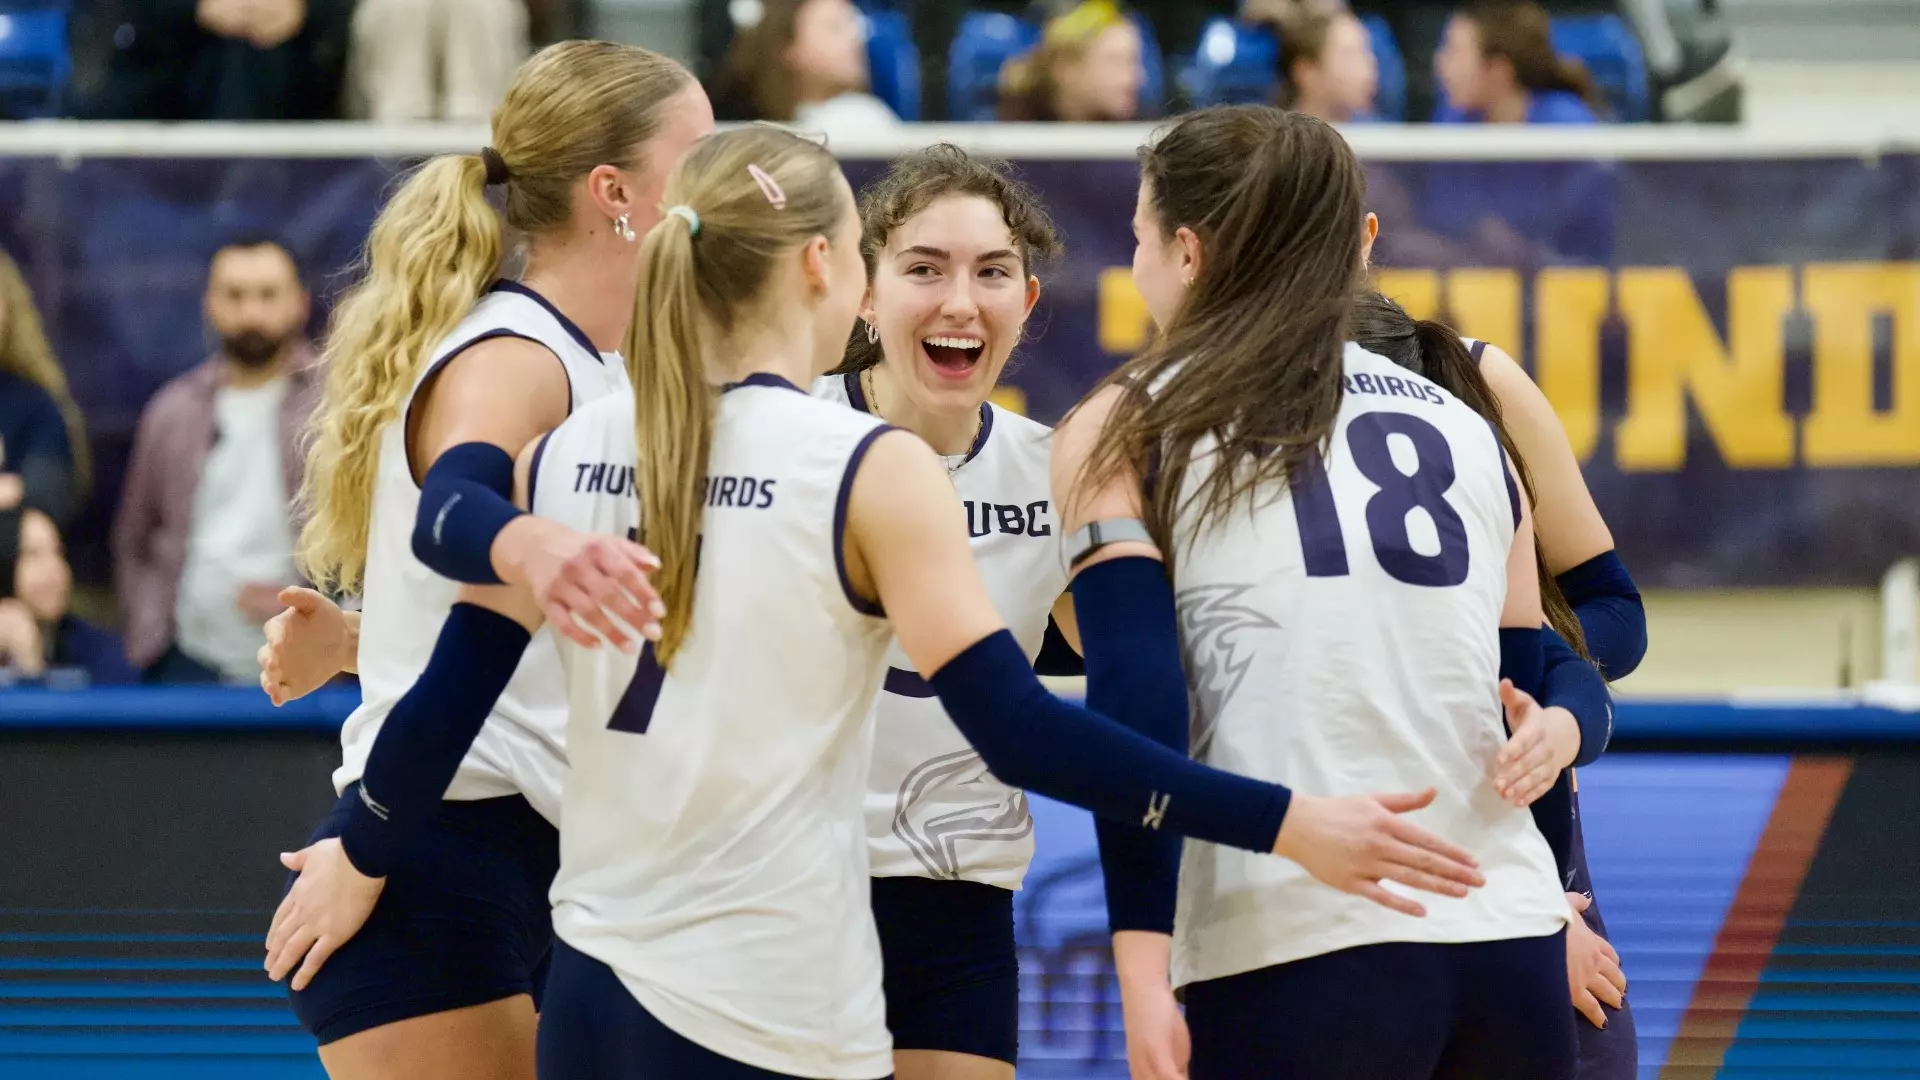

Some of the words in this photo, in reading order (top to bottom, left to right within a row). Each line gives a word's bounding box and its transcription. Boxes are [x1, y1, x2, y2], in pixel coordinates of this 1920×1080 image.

[1099, 263, 1919, 470] UND
[574, 462, 777, 508] THUNIRDS
[963, 500, 1051, 538] UBC
[1257, 411, 1469, 587] 18
